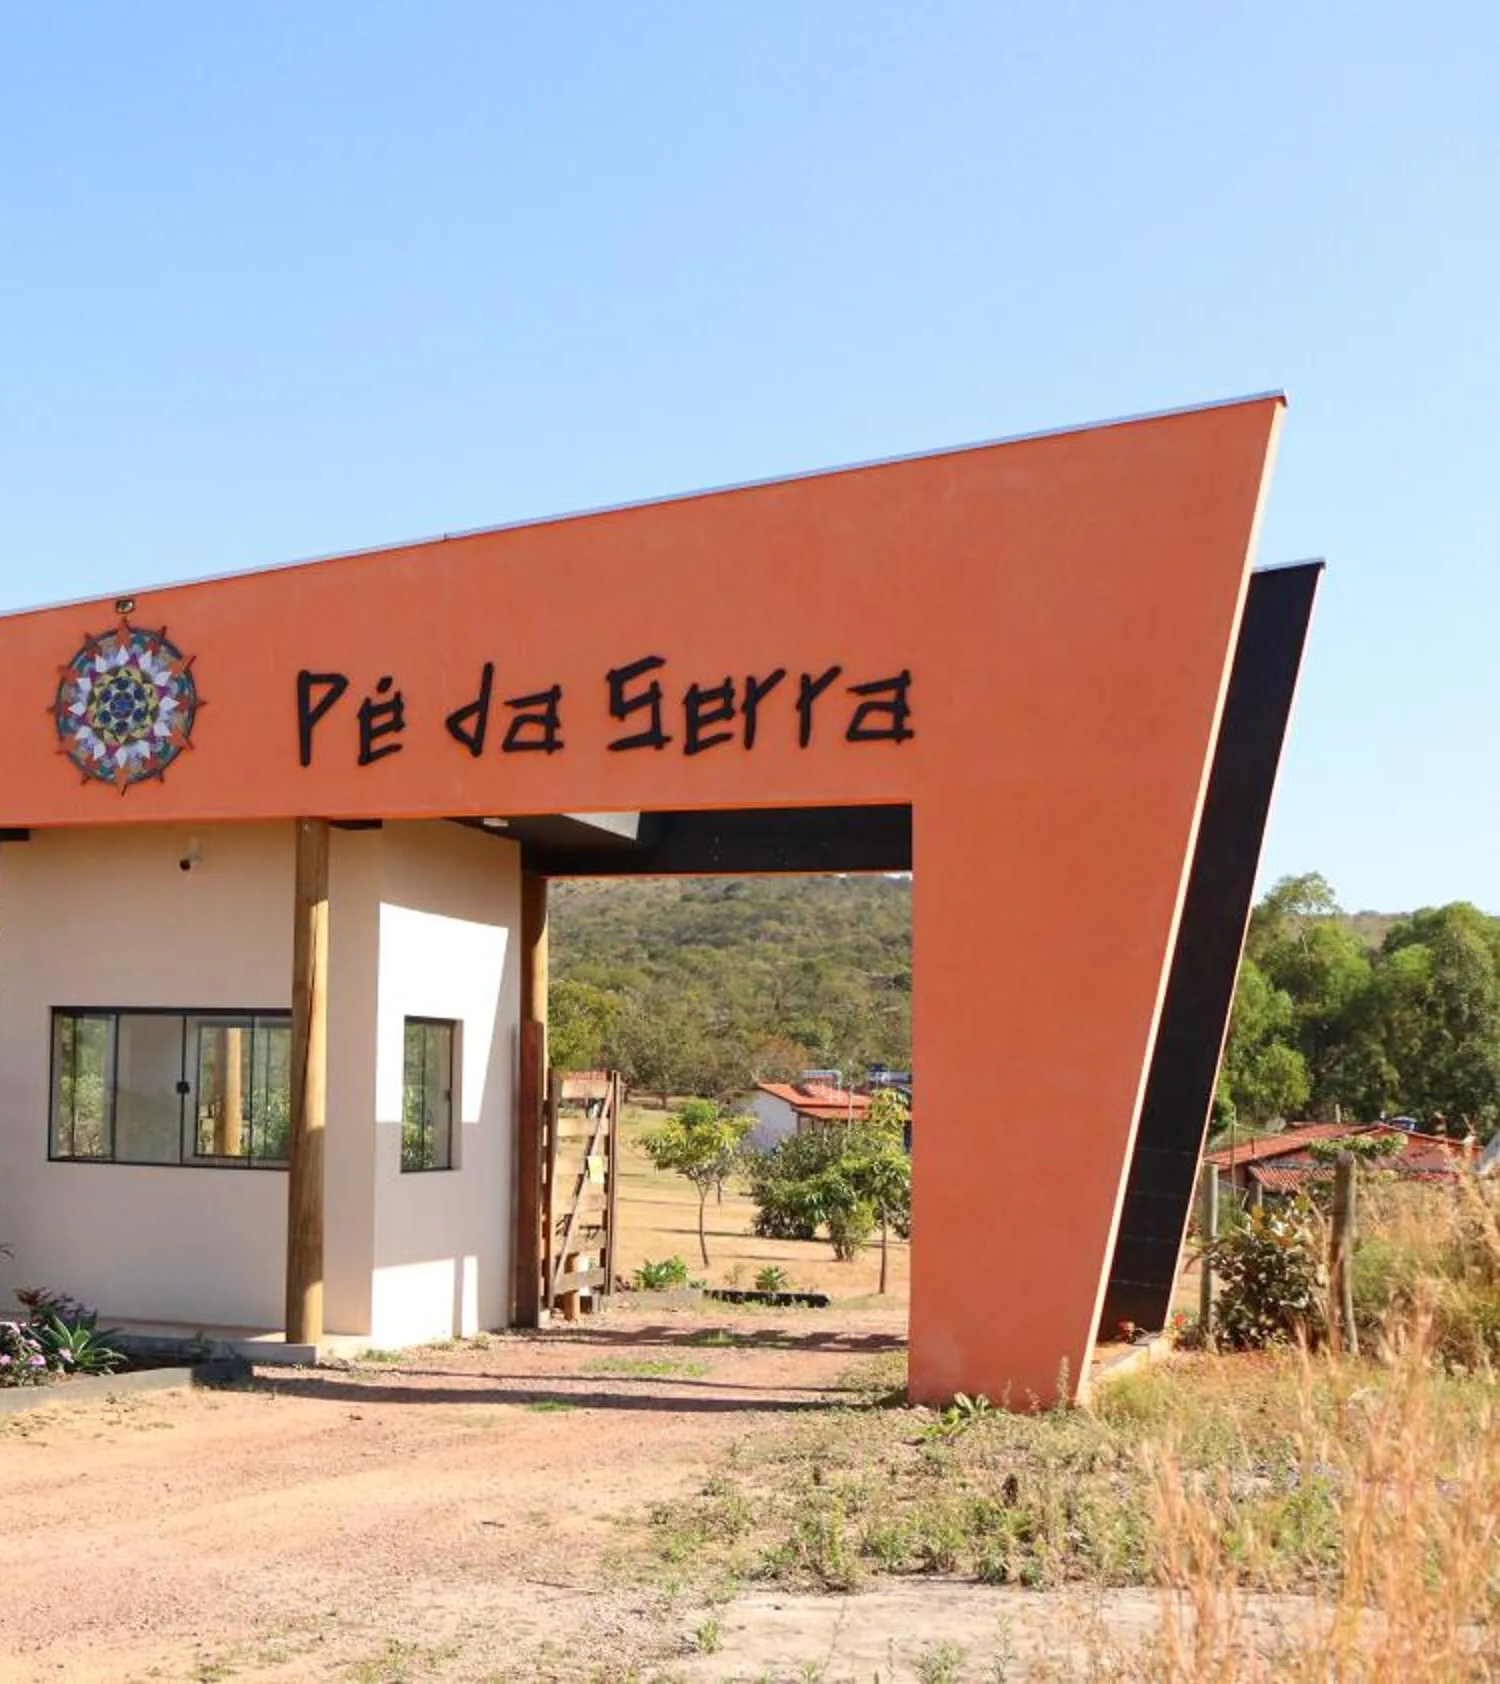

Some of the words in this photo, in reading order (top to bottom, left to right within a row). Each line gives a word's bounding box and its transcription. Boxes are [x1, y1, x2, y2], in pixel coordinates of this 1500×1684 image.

[296, 670, 406, 768] Pé
[445, 662, 564, 758] da
[605, 655, 915, 756] Serra
